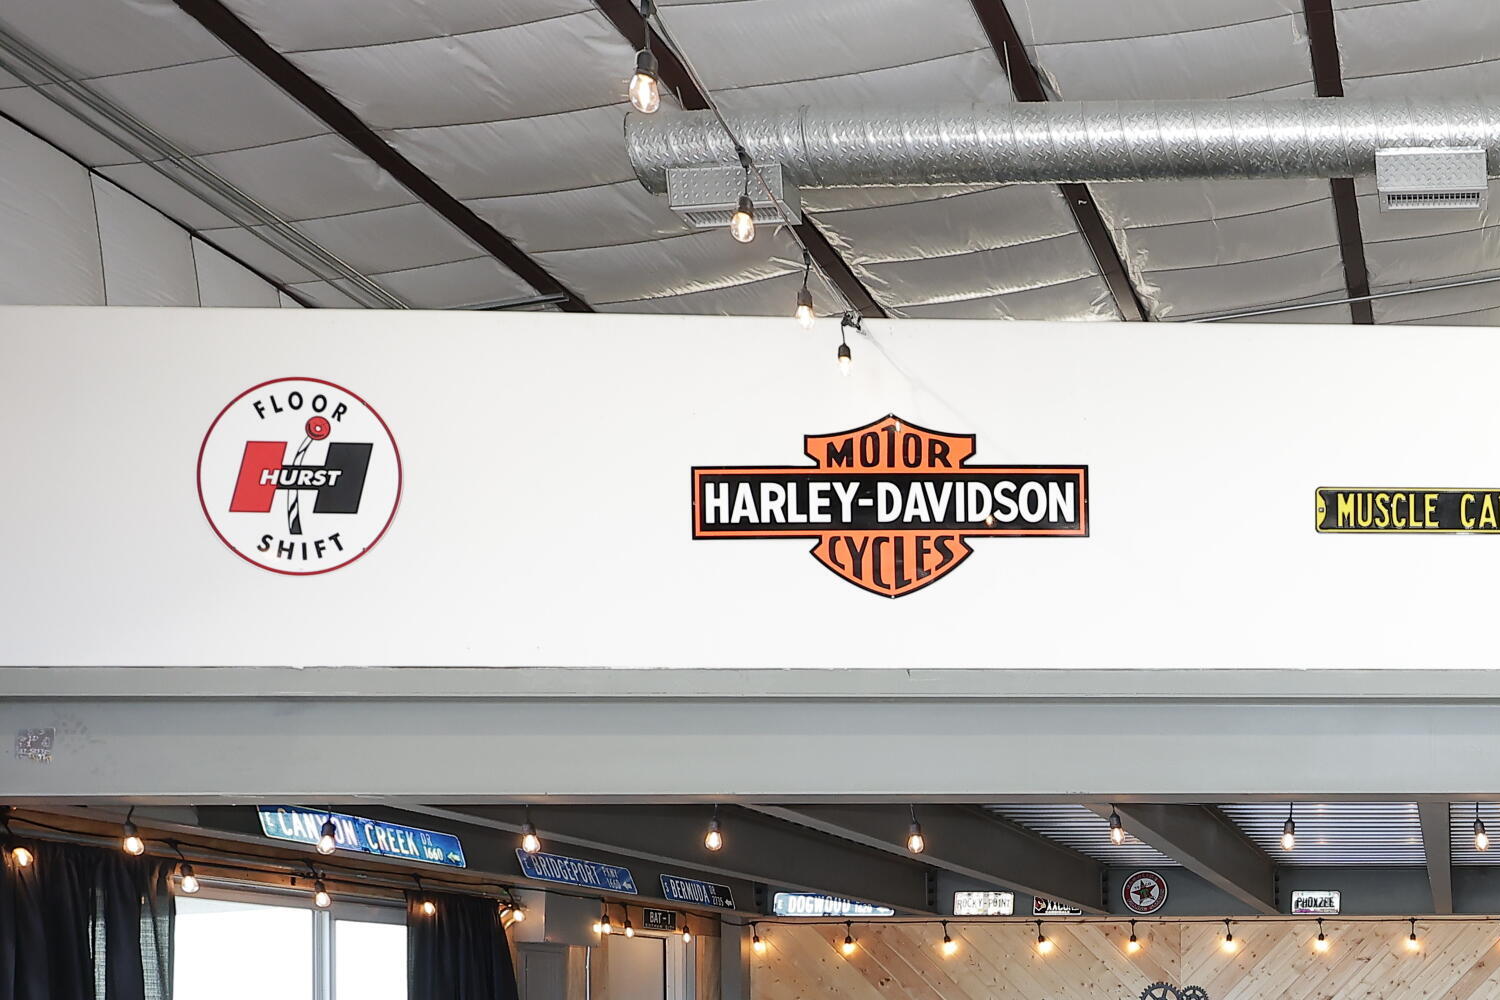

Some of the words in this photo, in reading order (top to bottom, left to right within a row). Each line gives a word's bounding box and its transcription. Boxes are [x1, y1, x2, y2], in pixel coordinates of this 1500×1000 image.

[253, 391, 348, 422] FLOOR
[826, 424, 953, 469] MOTOR
[258, 468, 342, 487] HURST
[705, 481, 1075, 524] HARLEY-DAVIDSON
[1337, 493, 1439, 528] MUSCLE
[257, 532, 344, 561] SHIFT
[828, 535, 955, 590] CYCLES
[364, 822, 420, 857] CREEK
[530, 855, 601, 885] BRIDGEPORT
[669, 879, 711, 904] BERMUDA
[787, 895, 850, 913] DOGWOOD
